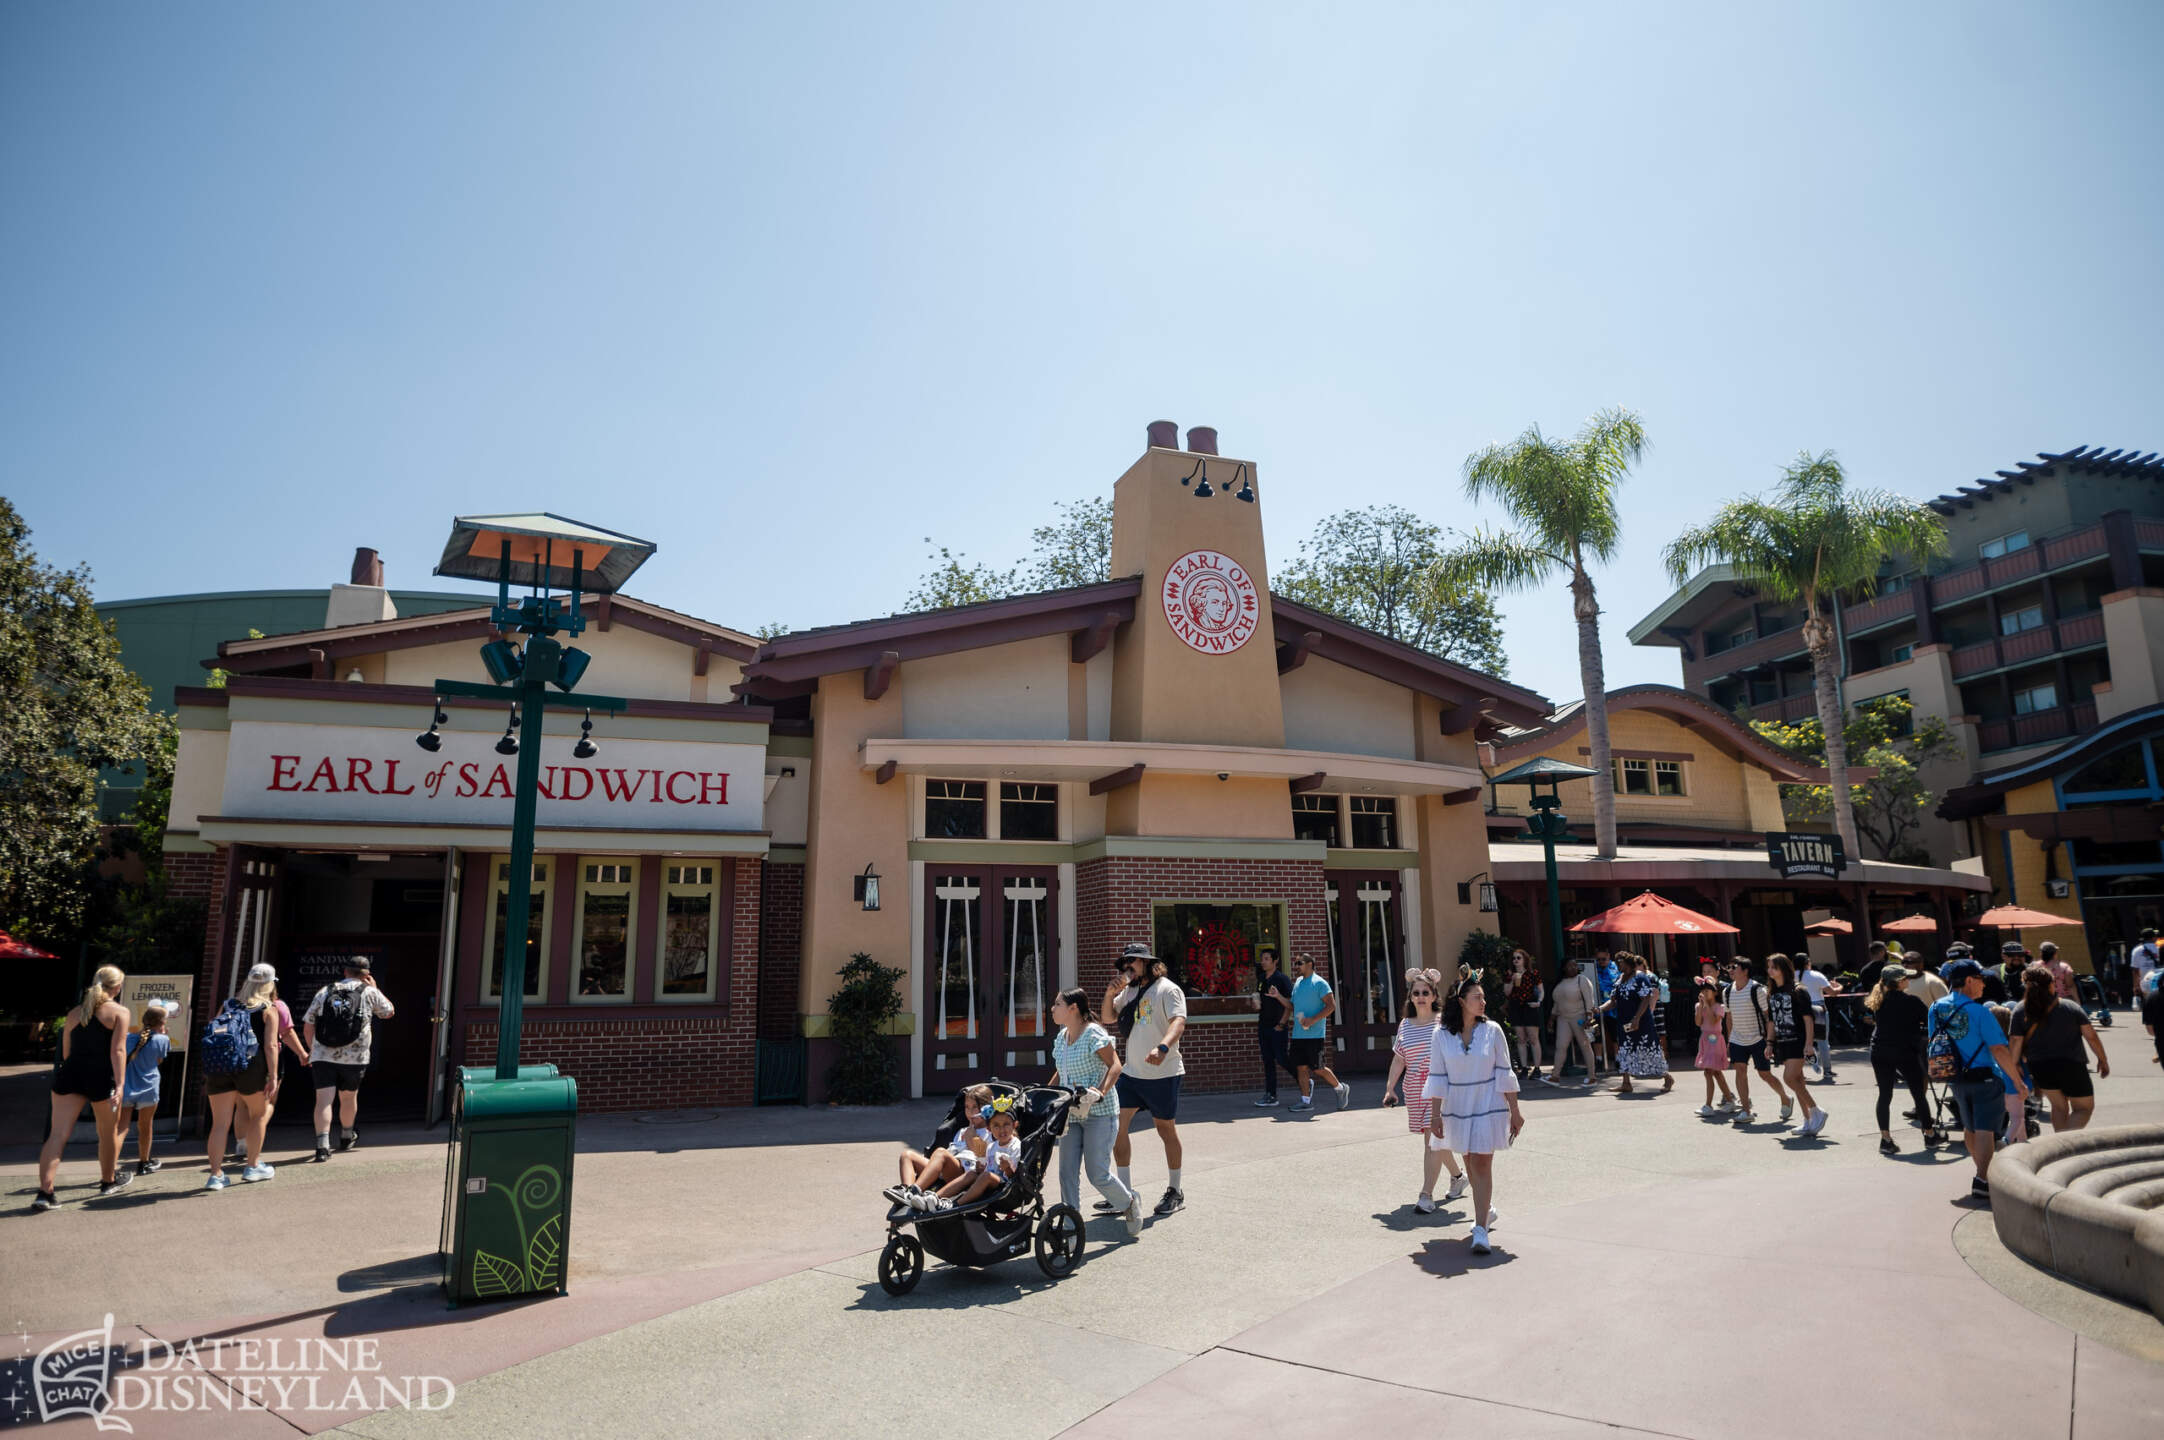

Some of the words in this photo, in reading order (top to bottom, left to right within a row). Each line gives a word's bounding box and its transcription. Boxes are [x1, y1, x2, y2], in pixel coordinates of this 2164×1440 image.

[1173, 554, 1224, 581] EARL
[1229, 567, 1252, 591] OF
[1167, 603, 1254, 651] SANDWICH
[266, 755, 415, 795] EARL
[425, 761, 453, 798] of
[455, 763, 731, 805] SANDWICH
[1781, 841, 1833, 863] TAVERN
[1788, 865, 1821, 873] RESTAURANT
[1824, 866, 1834, 874] BAR
[132, 992, 181, 1001] LEMONADE
[140, 983, 175, 992] FROZEN
